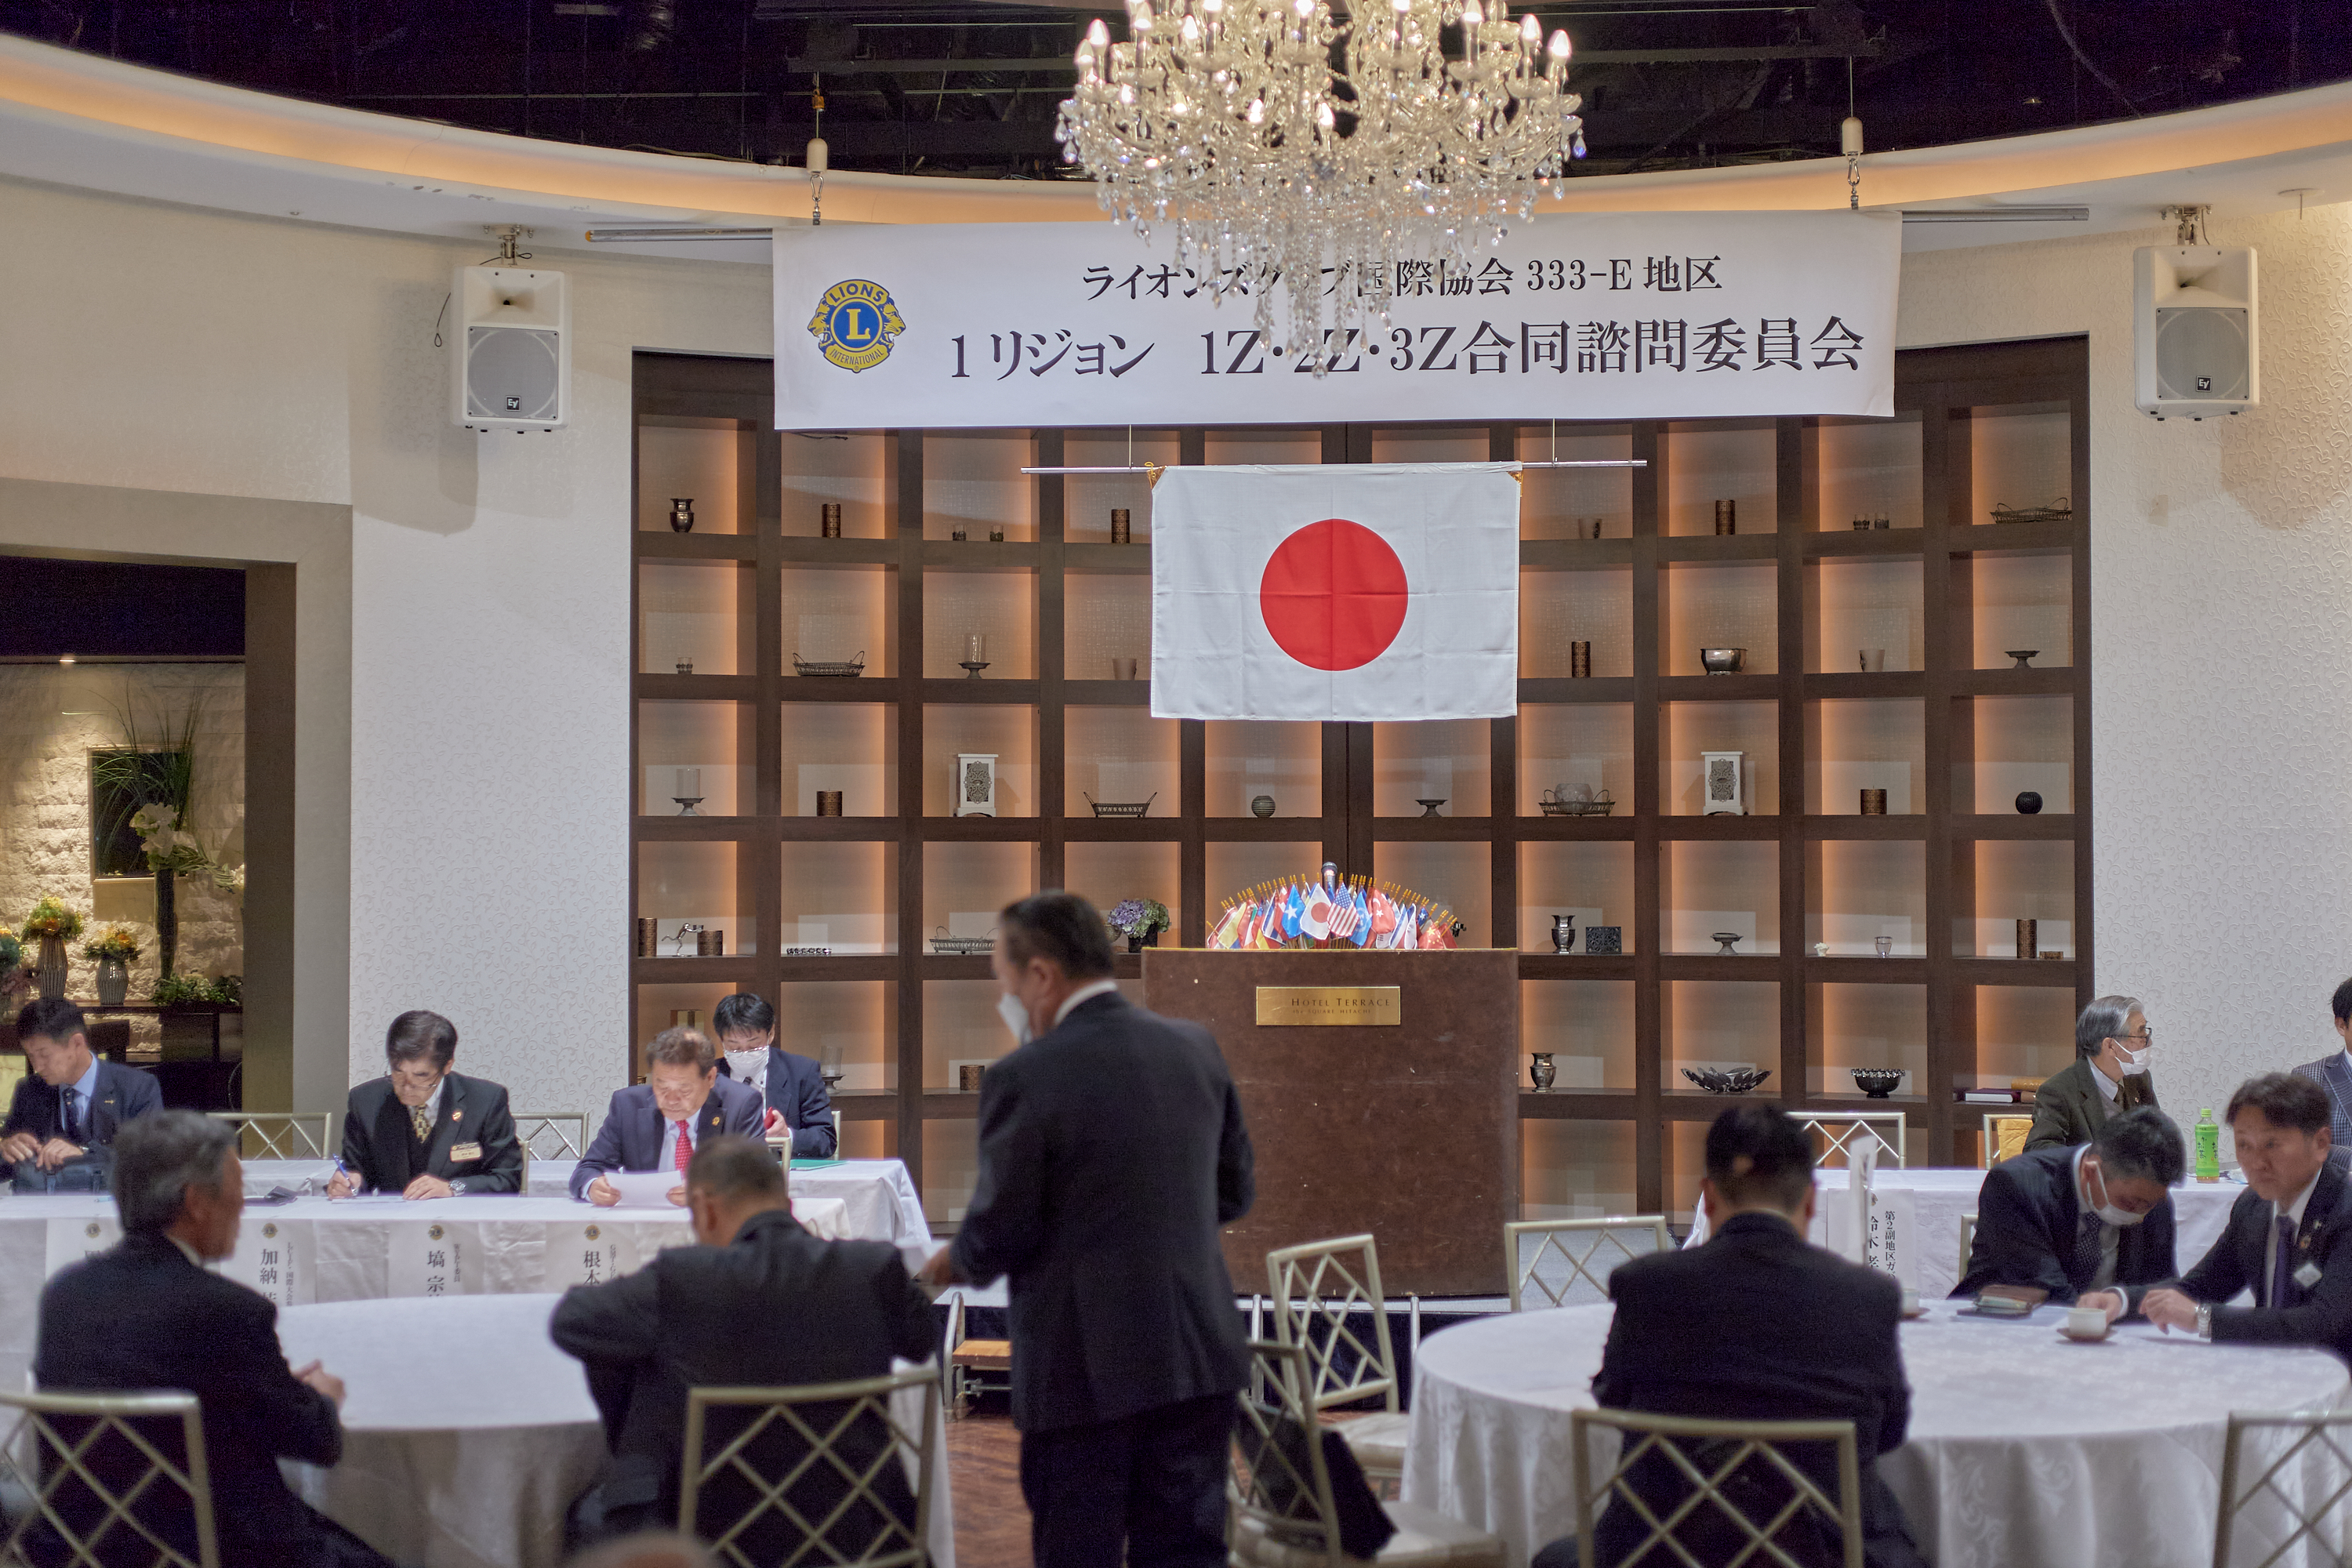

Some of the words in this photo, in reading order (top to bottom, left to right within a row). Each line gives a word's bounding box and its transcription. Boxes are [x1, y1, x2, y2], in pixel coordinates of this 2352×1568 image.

[1528, 260, 1632, 292] 333-E
[1643, 255, 1722, 292] 地区
[829, 283, 884, 303] LIONS
[847, 308, 870, 339] L
[829, 348, 884, 365] INTERNATIONAL
[1291, 998, 1330, 1007] HOTEL
[1336, 997, 1390, 1007] TERRACE
